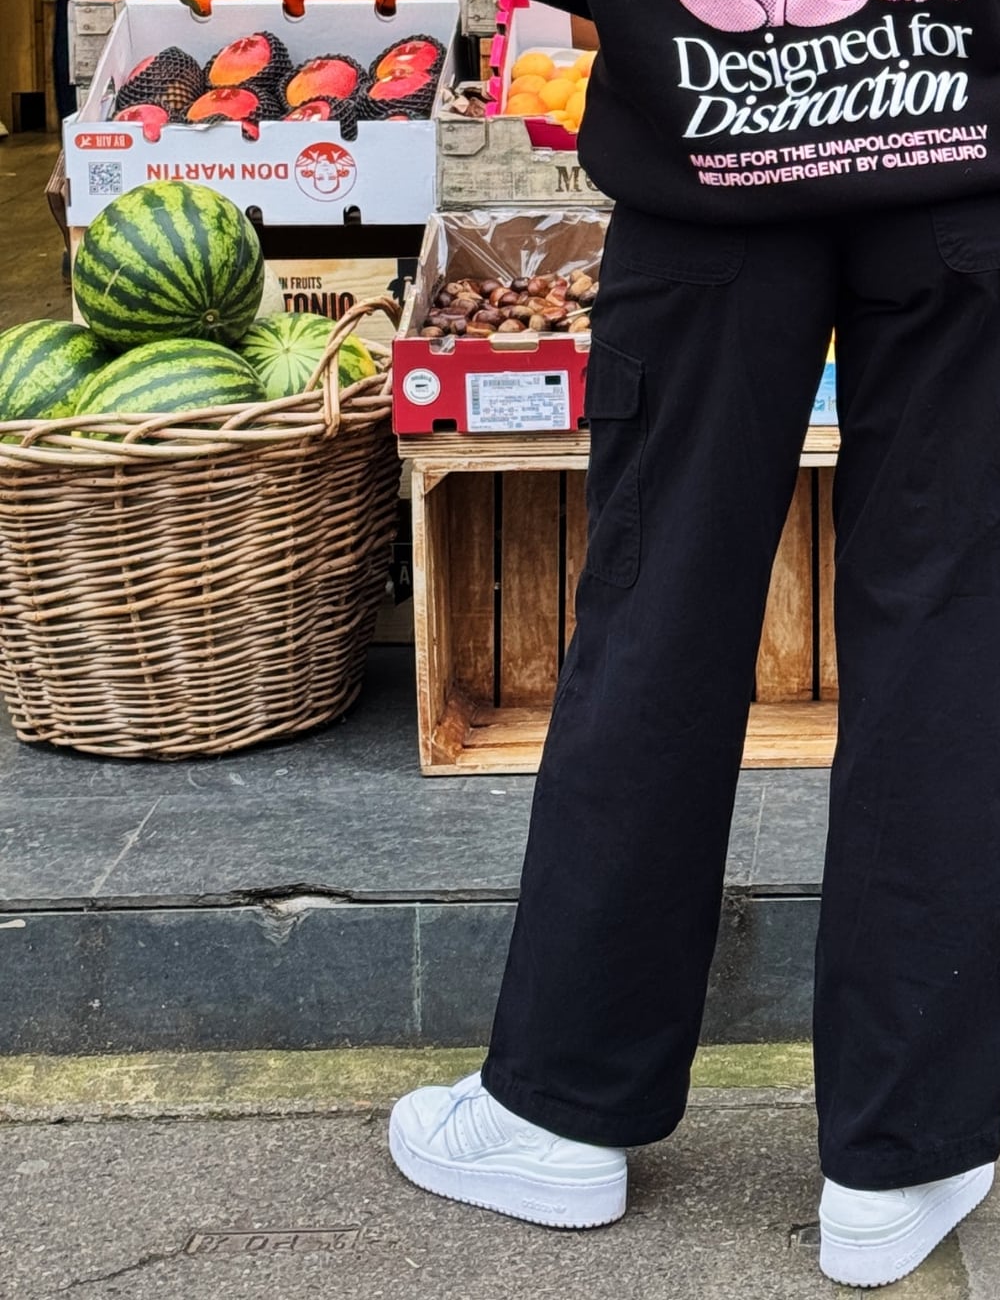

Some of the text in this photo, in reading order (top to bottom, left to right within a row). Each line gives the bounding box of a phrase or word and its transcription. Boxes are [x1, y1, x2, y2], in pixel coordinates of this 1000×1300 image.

[672, 13, 973, 97] Designed for
[682, 59, 969, 139] Distraction
[95, 135, 126, 148] BY AIR
[690, 125, 988, 169] MADE FOR THE UNAPOLOGETICALLY
[146, 163, 289, 181] DON MARTIN
[699, 158, 852, 186] NEURODIVERGENT
[857, 155, 879, 172] BY
[290, 277, 322, 290] FRUITS
